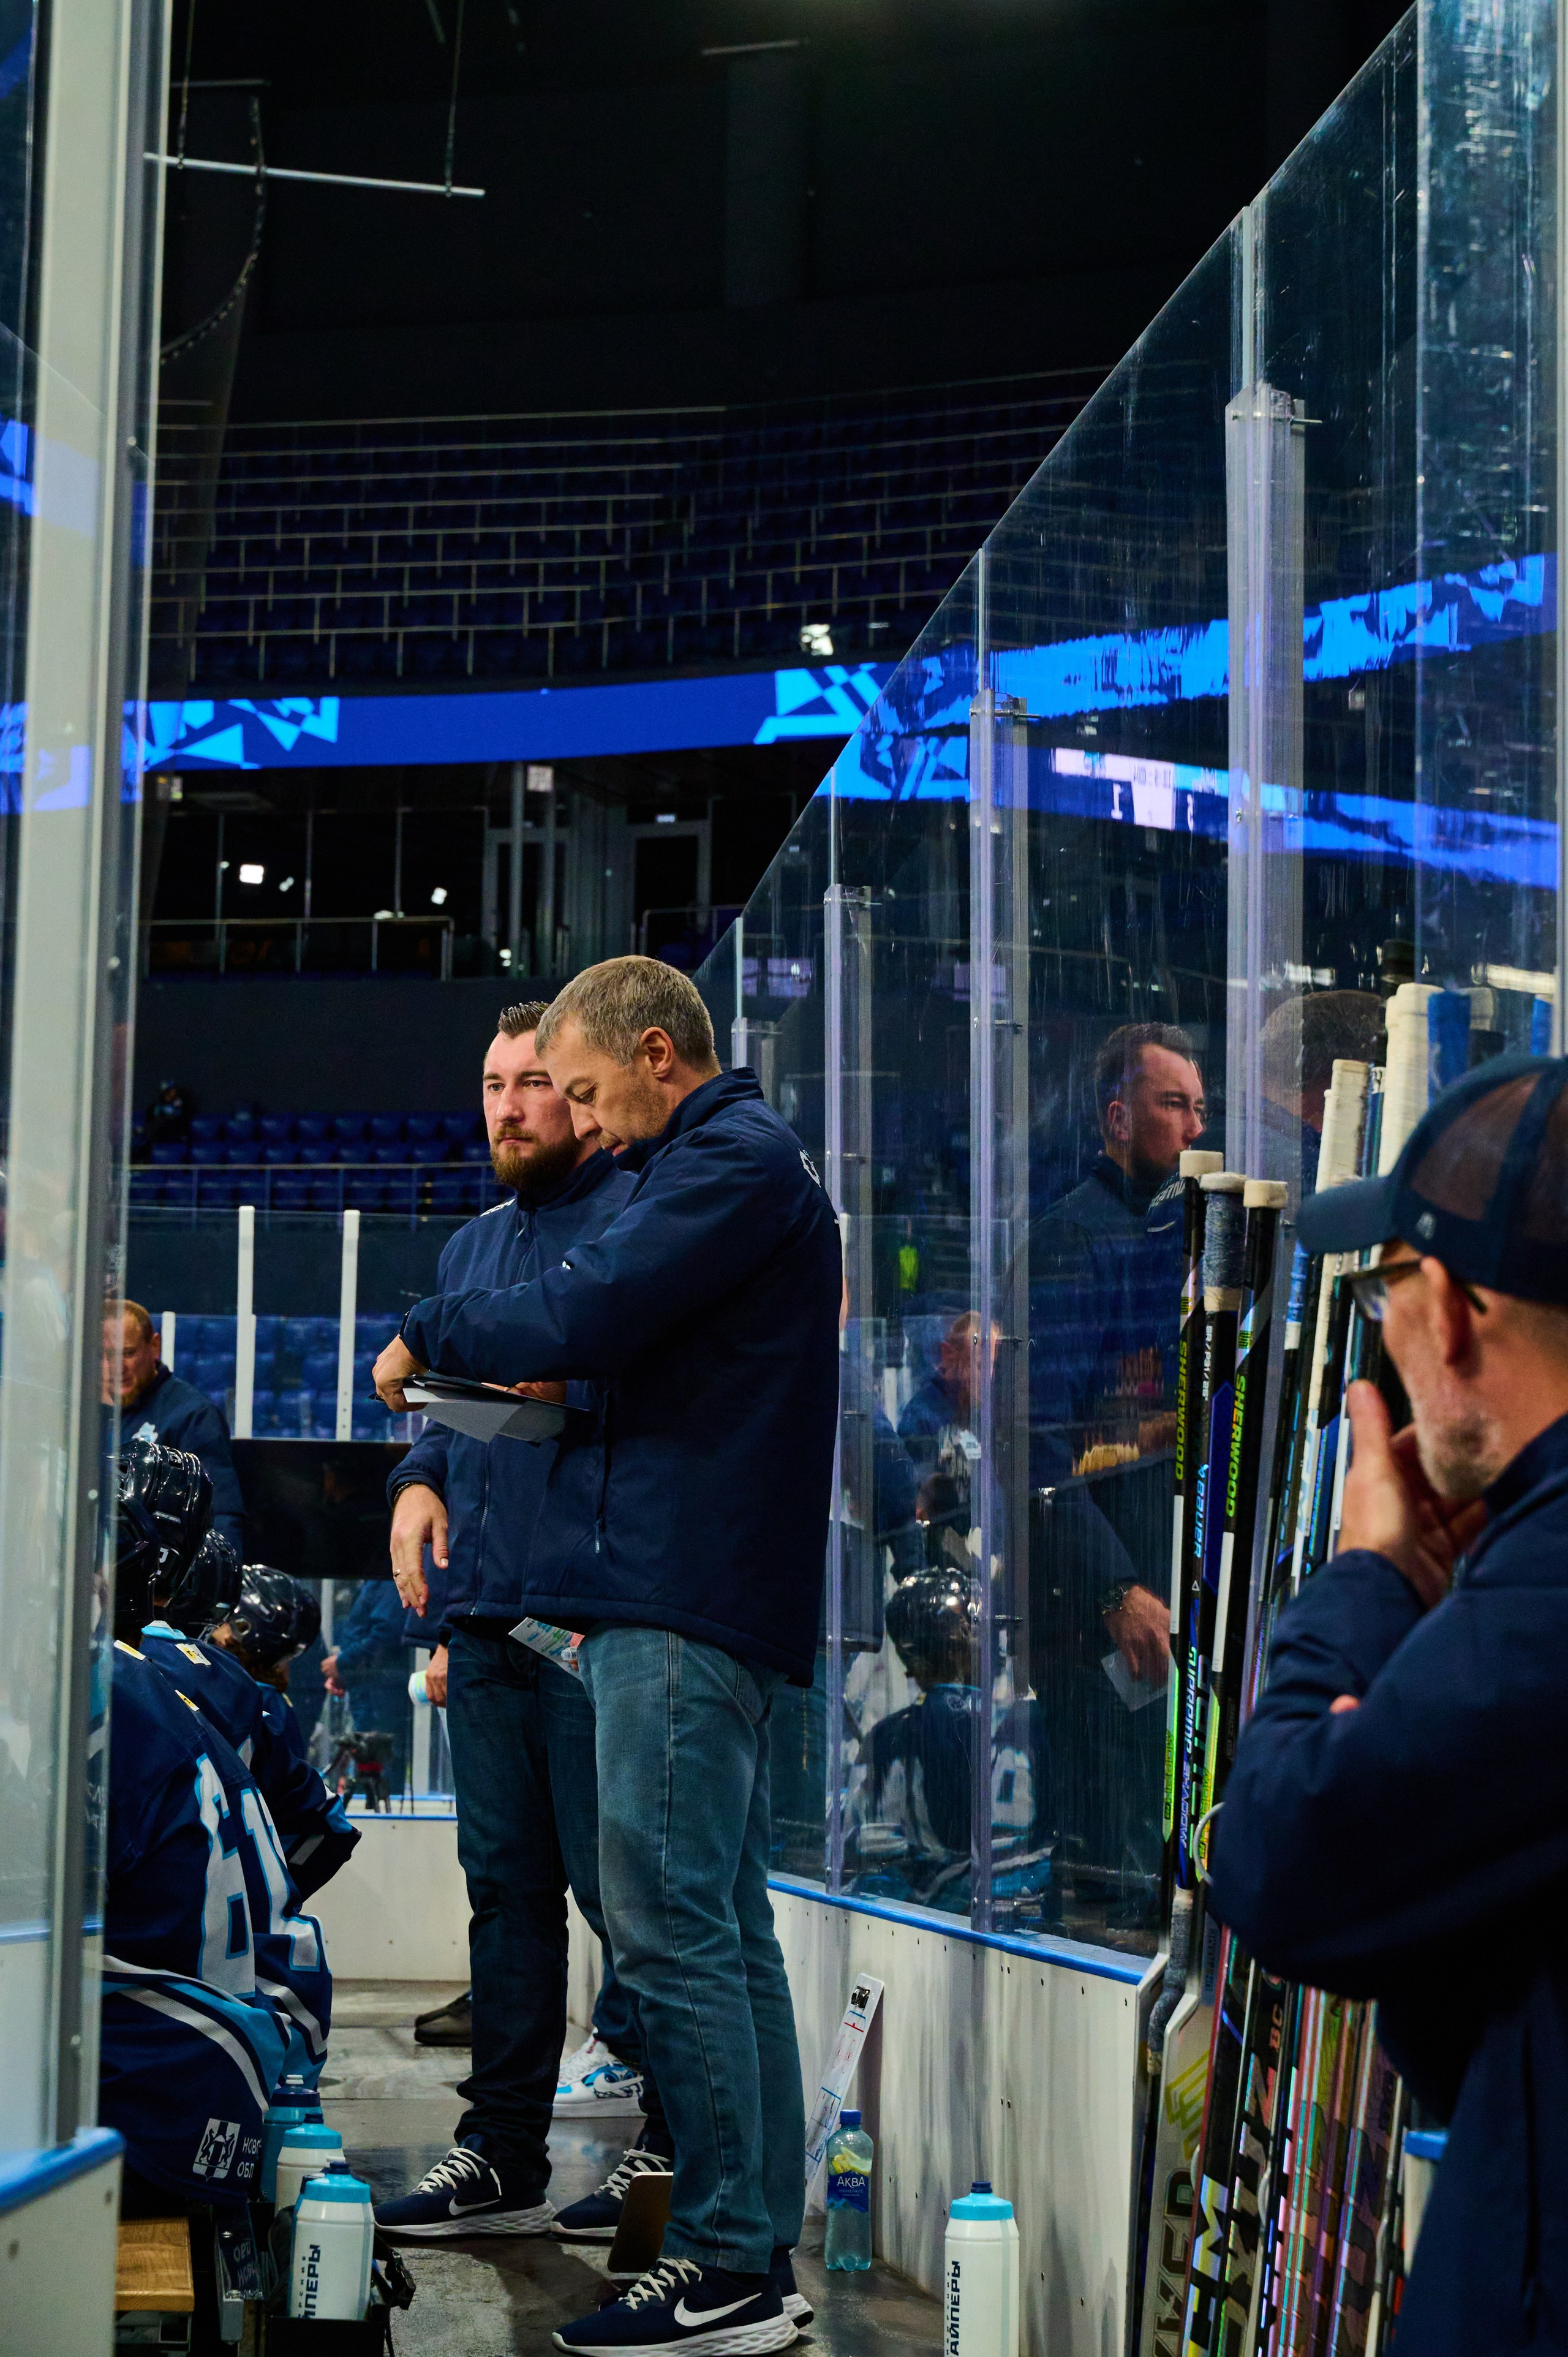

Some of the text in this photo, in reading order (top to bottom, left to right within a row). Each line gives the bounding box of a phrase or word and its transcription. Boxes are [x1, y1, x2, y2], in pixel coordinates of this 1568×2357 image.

[1175, 1340, 1188, 1481] SHERWOOD
[1226, 1373, 1246, 1518] SHERWOOD
[1194, 1481, 1205, 1558] BAUER
[1178, 1760, 1191, 1849] SHADOW
[837, 2176, 865, 2189] АКВА
